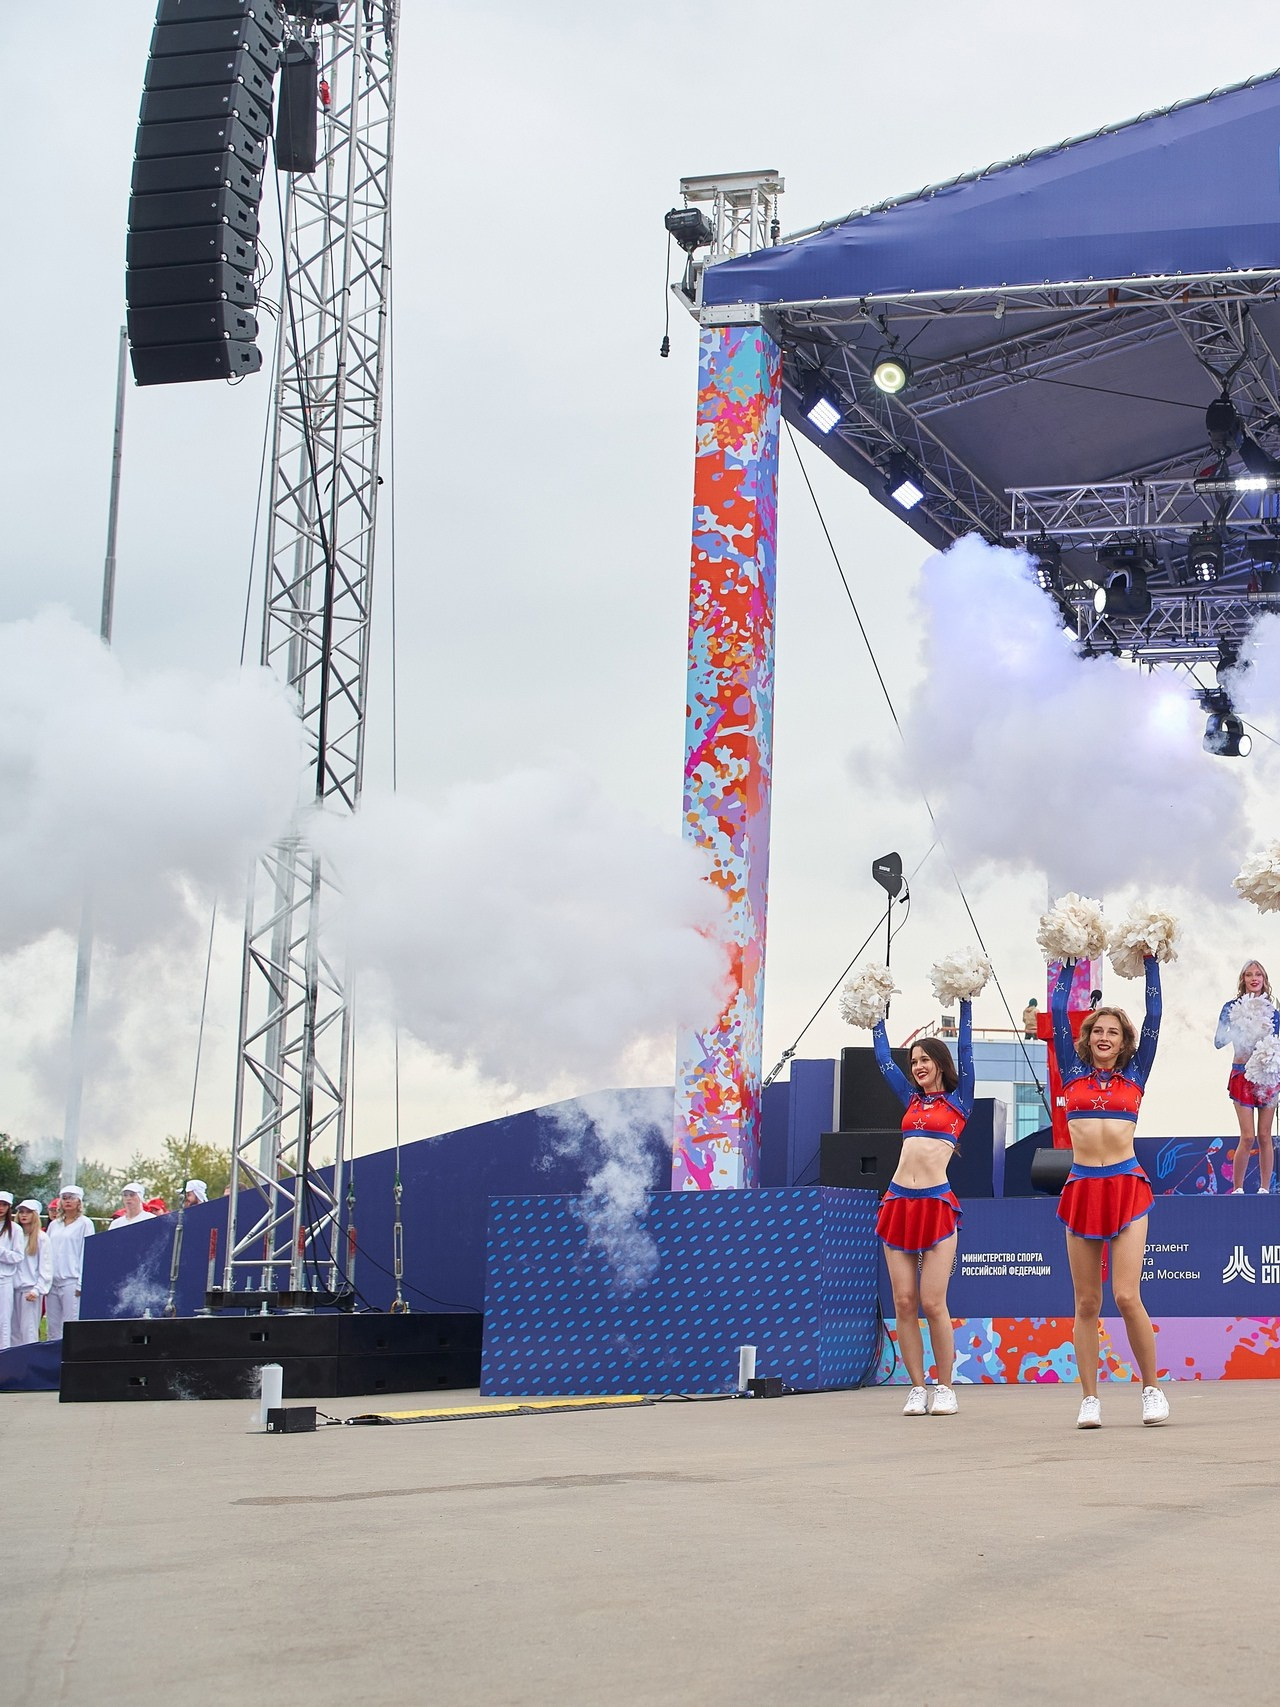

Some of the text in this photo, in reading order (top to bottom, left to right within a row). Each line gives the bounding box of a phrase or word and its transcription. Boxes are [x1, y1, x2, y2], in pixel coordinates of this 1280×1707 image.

[1144, 1244, 1189, 1254] ртамент
[962, 1253, 1043, 1262] МИНИСТЕРСТВО СПОРТА
[962, 1265, 1051, 1276] РОССИЙСКОЙ ФЕДЕРАЦИИ
[1158, 1269, 1200, 1279] Москвы
